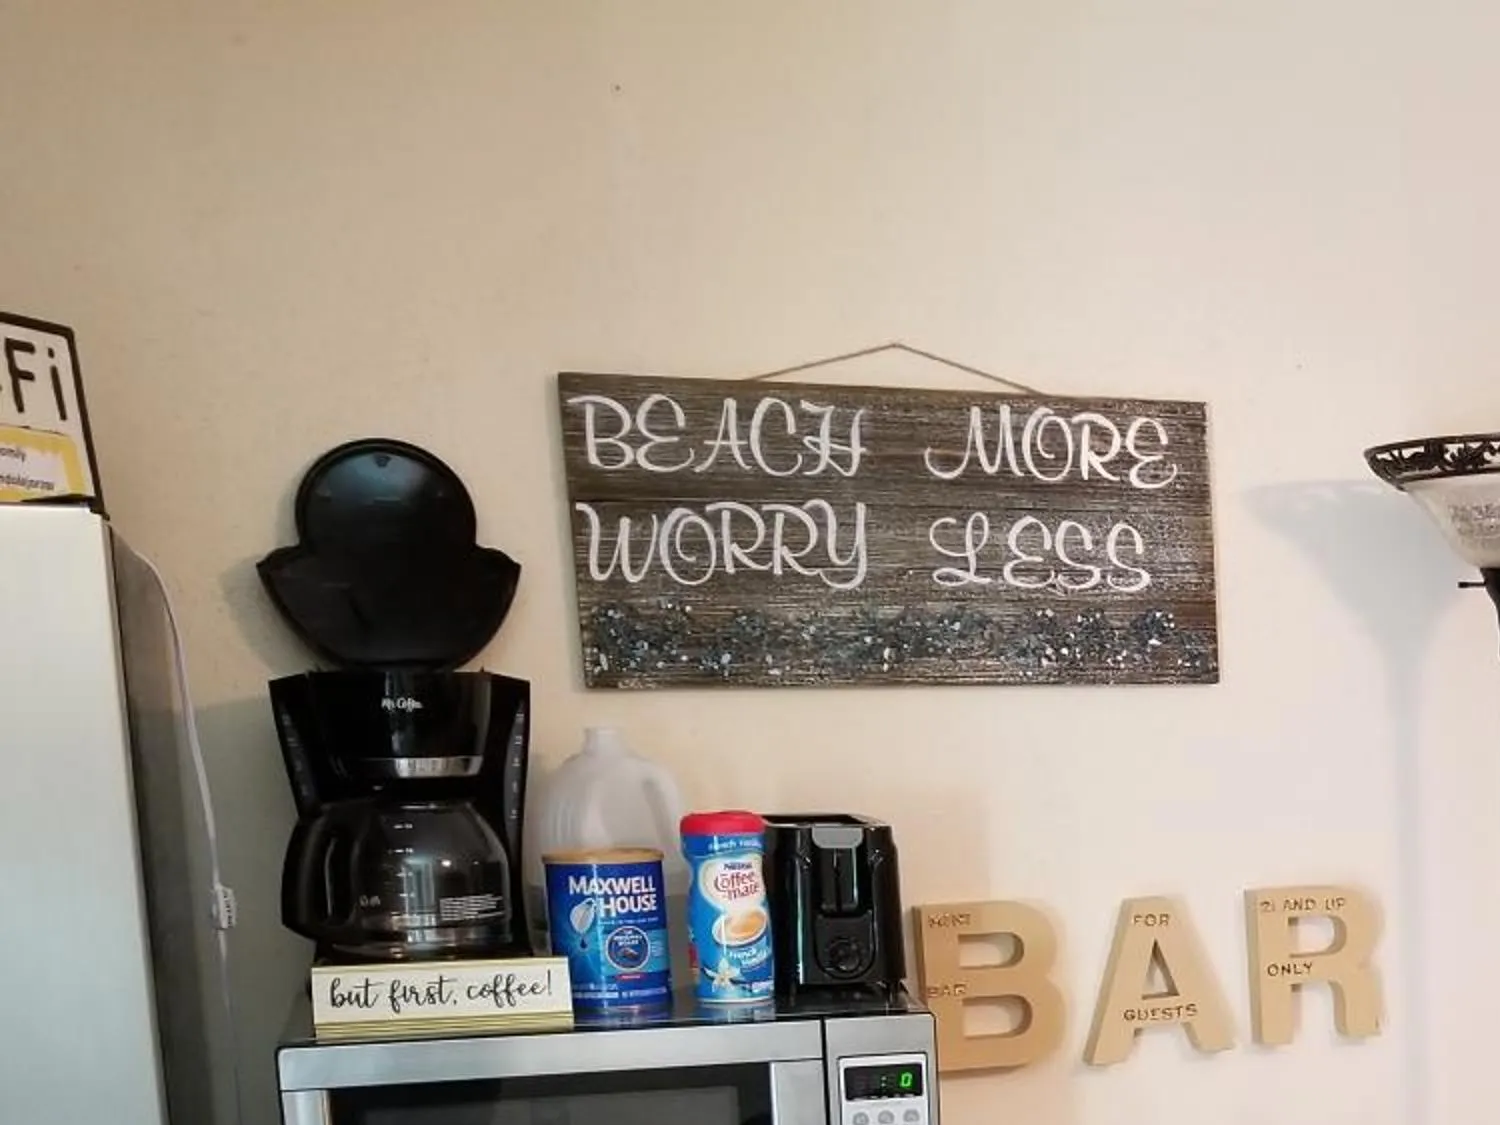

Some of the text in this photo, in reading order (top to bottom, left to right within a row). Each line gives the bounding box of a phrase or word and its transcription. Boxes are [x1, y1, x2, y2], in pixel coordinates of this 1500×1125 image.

[2, 337, 68, 421] Fi
[567, 394, 1178, 489] BEACH MORE
[576, 500, 1151, 593] WORRY LESS
[568, 875, 657, 896] MAXWELL
[599, 894, 657, 918] HOUSE
[1283, 897, 1317, 911] AND
[1133, 913, 1170, 927] FOR
[912, 885, 1384, 1073] BAR
[1267, 962, 1313, 977] ONLY
[330, 977, 384, 1009] but
[467, 969, 553, 1008] coffee!
[1123, 1003, 1198, 1021] GUESTS
